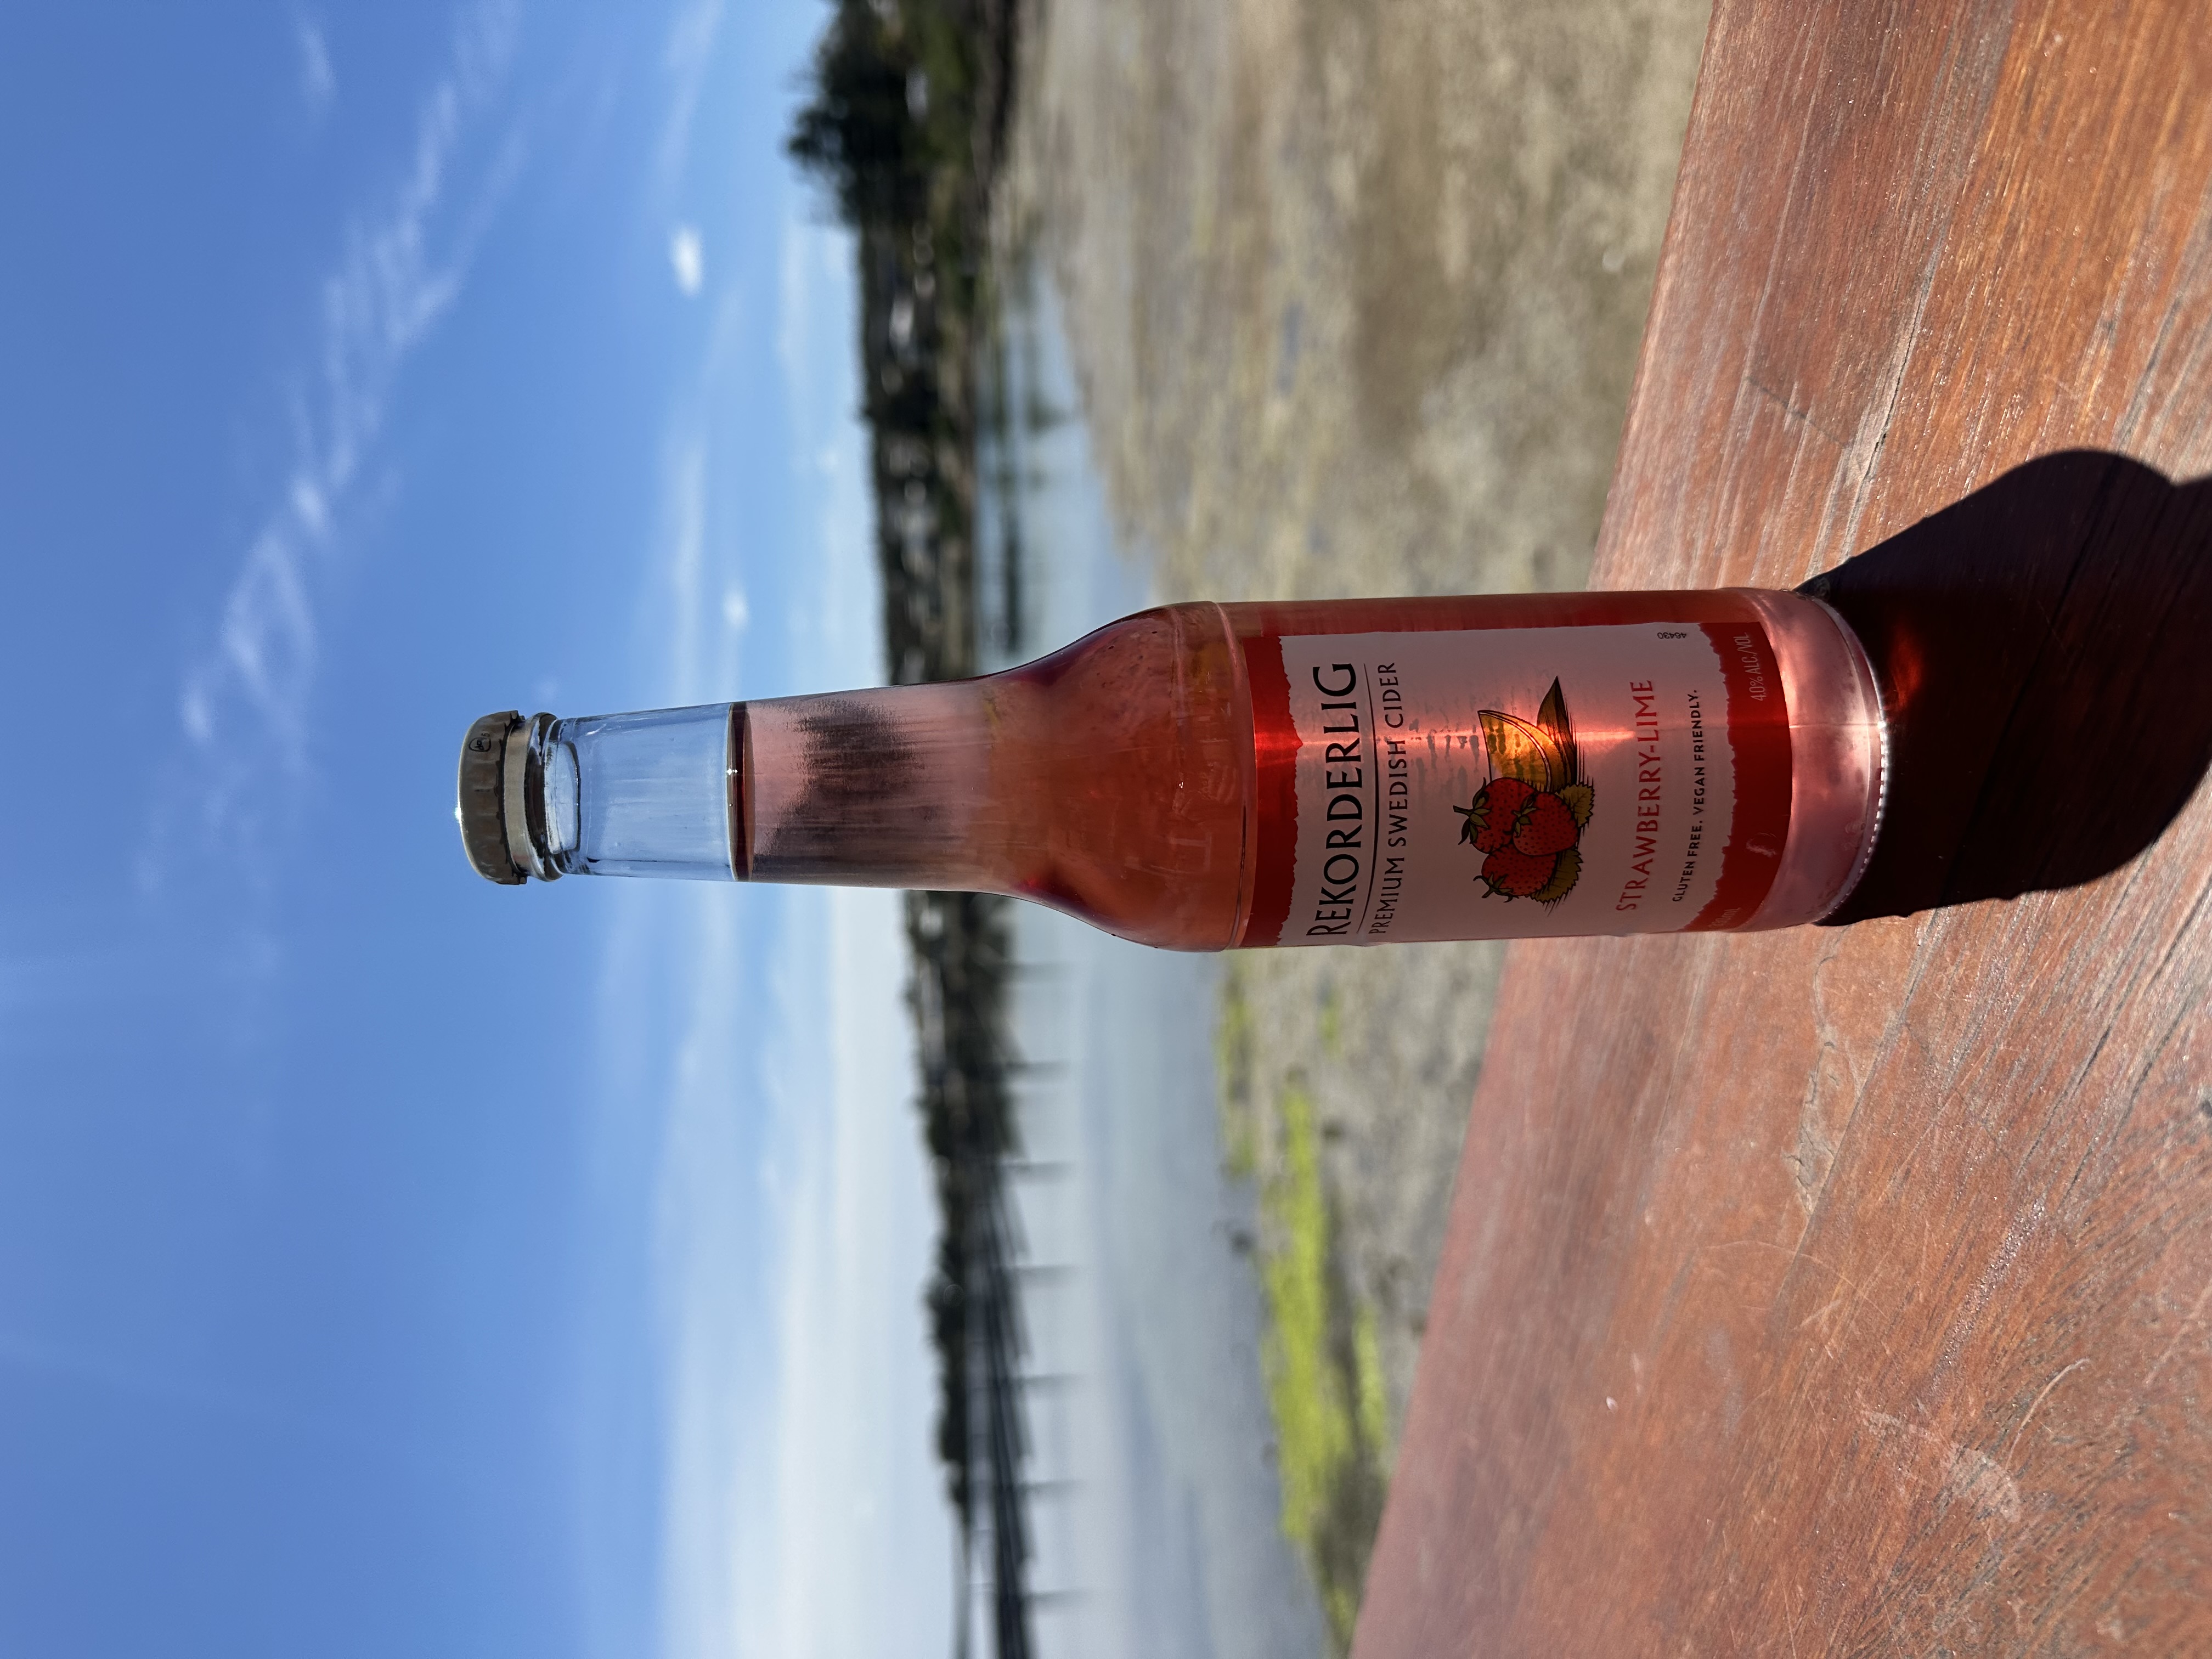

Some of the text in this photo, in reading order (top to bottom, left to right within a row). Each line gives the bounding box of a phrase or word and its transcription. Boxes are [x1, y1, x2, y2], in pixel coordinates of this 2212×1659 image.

[1733, 631, 1767, 702] 4.0% ALC./VOL.
[1305, 663, 1363, 936] REKORDERLIG
[1368, 662, 1408, 934] PREMIUM SWEDISH CIDER
[1616, 680, 1661, 911] STRAWBERRY-LIME
[1672, 690, 1705, 902] GLUTEN FREE. VEGAN FRIENDLY.
